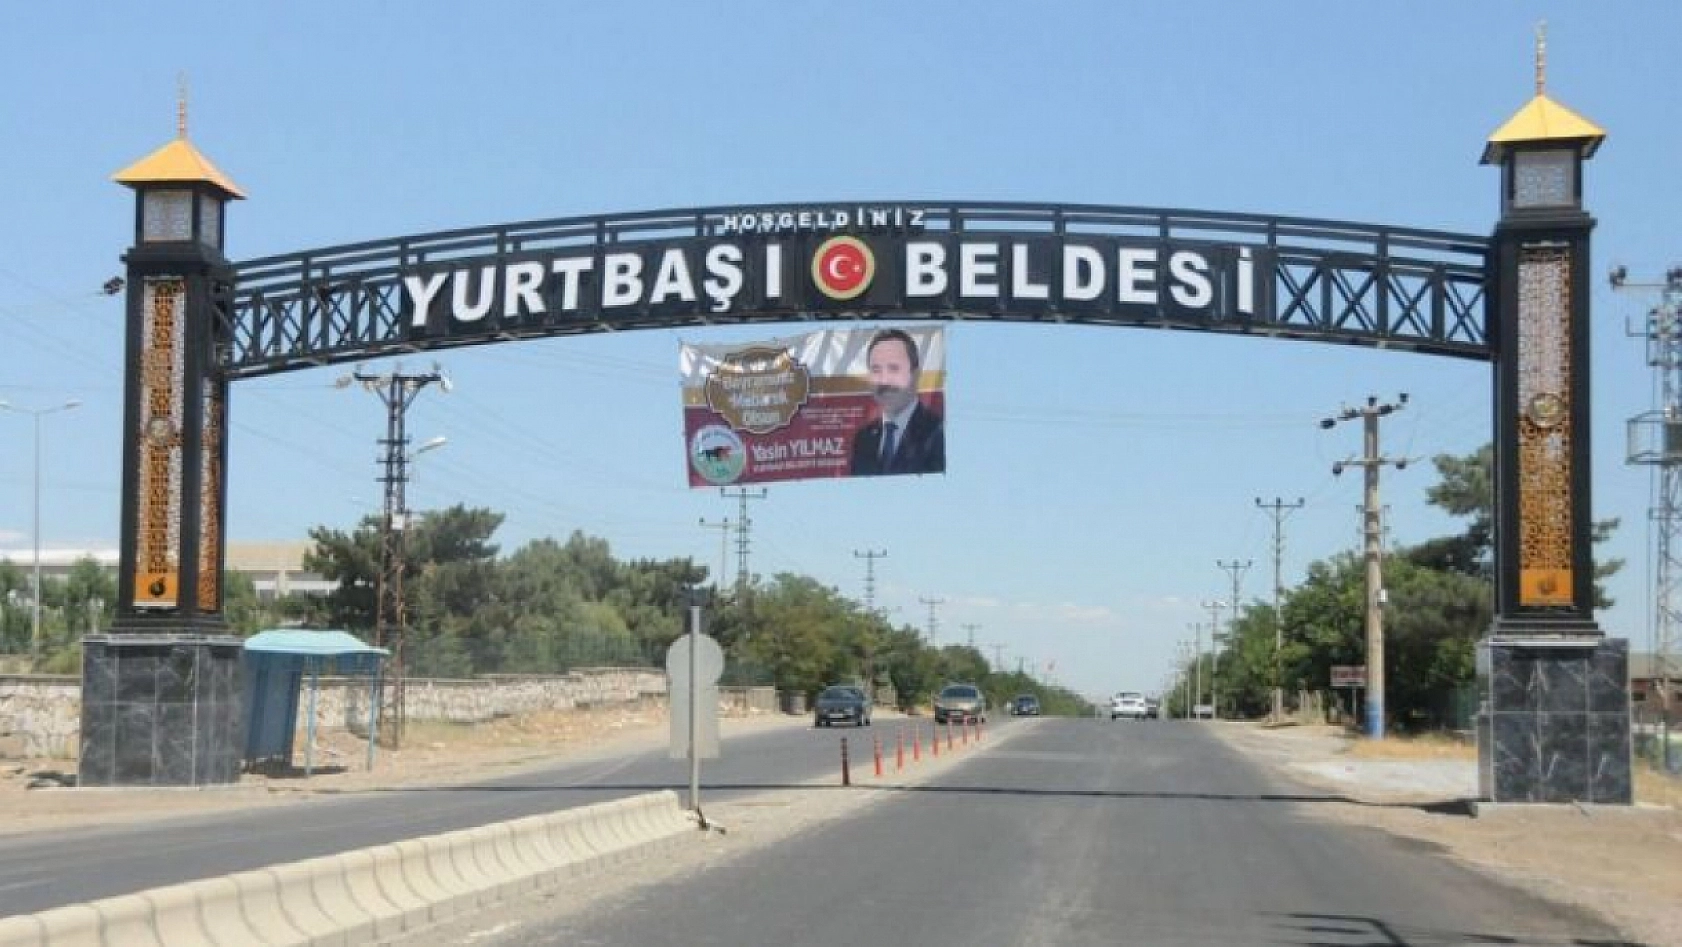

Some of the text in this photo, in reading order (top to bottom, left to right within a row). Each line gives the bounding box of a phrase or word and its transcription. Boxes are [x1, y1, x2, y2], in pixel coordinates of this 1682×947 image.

[403, 241, 1253, 327] YURTBAŞI BELDESİ
[752, 437, 845, 462] Yasin YILMAZ
